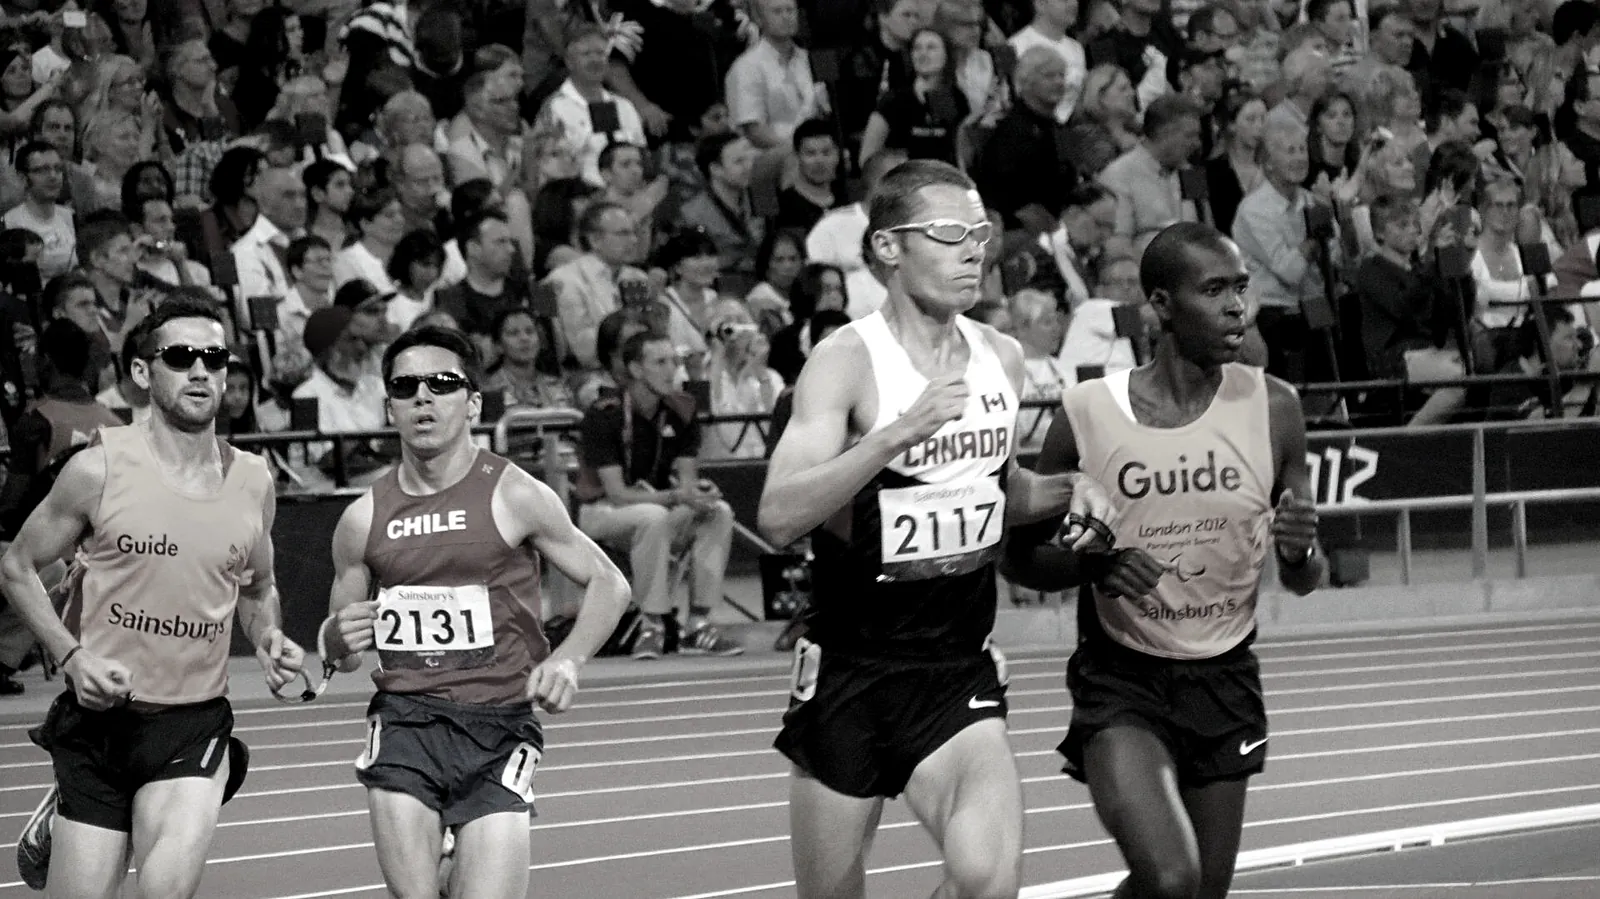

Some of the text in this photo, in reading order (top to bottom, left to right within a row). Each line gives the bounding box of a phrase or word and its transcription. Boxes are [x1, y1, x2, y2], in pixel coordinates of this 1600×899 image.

[903, 427, 1008, 467] CANADA
[1118, 450, 1242, 499] Guide
[387, 510, 467, 540] CHILE
[893, 501, 998, 556] 2117
[1138, 517, 1229, 538] London 2012
[117, 534, 178, 557] Guide
[381, 609, 476, 646] 2131
